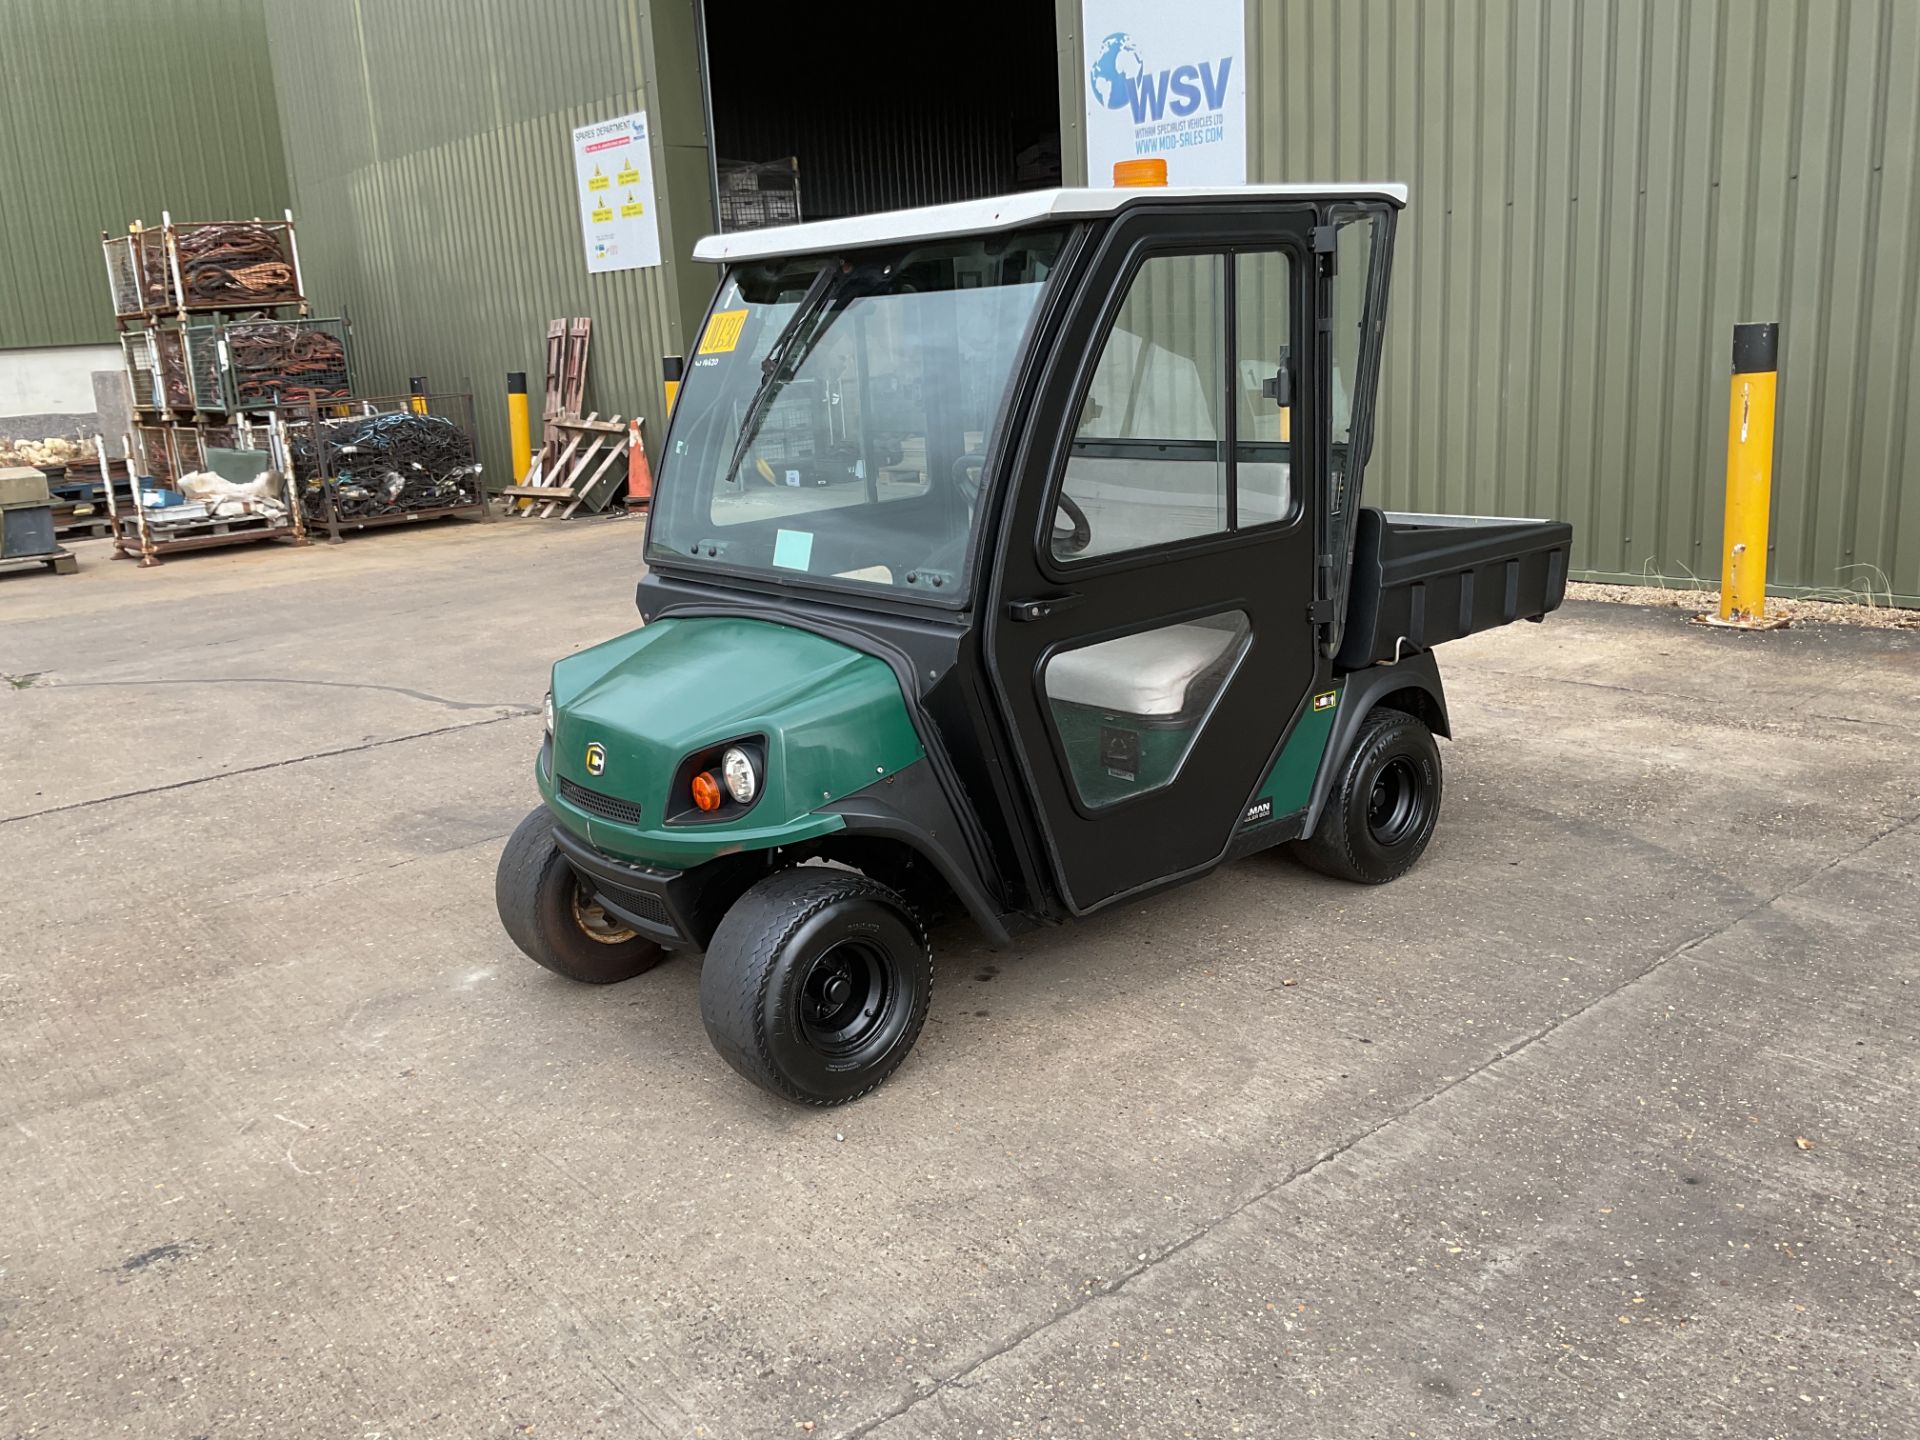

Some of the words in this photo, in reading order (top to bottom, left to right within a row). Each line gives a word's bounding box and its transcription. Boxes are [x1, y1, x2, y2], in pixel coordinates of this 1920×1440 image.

[1126, 57, 1232, 124] WSV
[575, 129, 595, 142] SPARES
[596, 120, 631, 136] DEPARTMENT
[1157, 120, 1186, 135] SPECIALIST
[1187, 116, 1212, 130] VEHICLES
[1213, 114, 1223, 126] LTD
